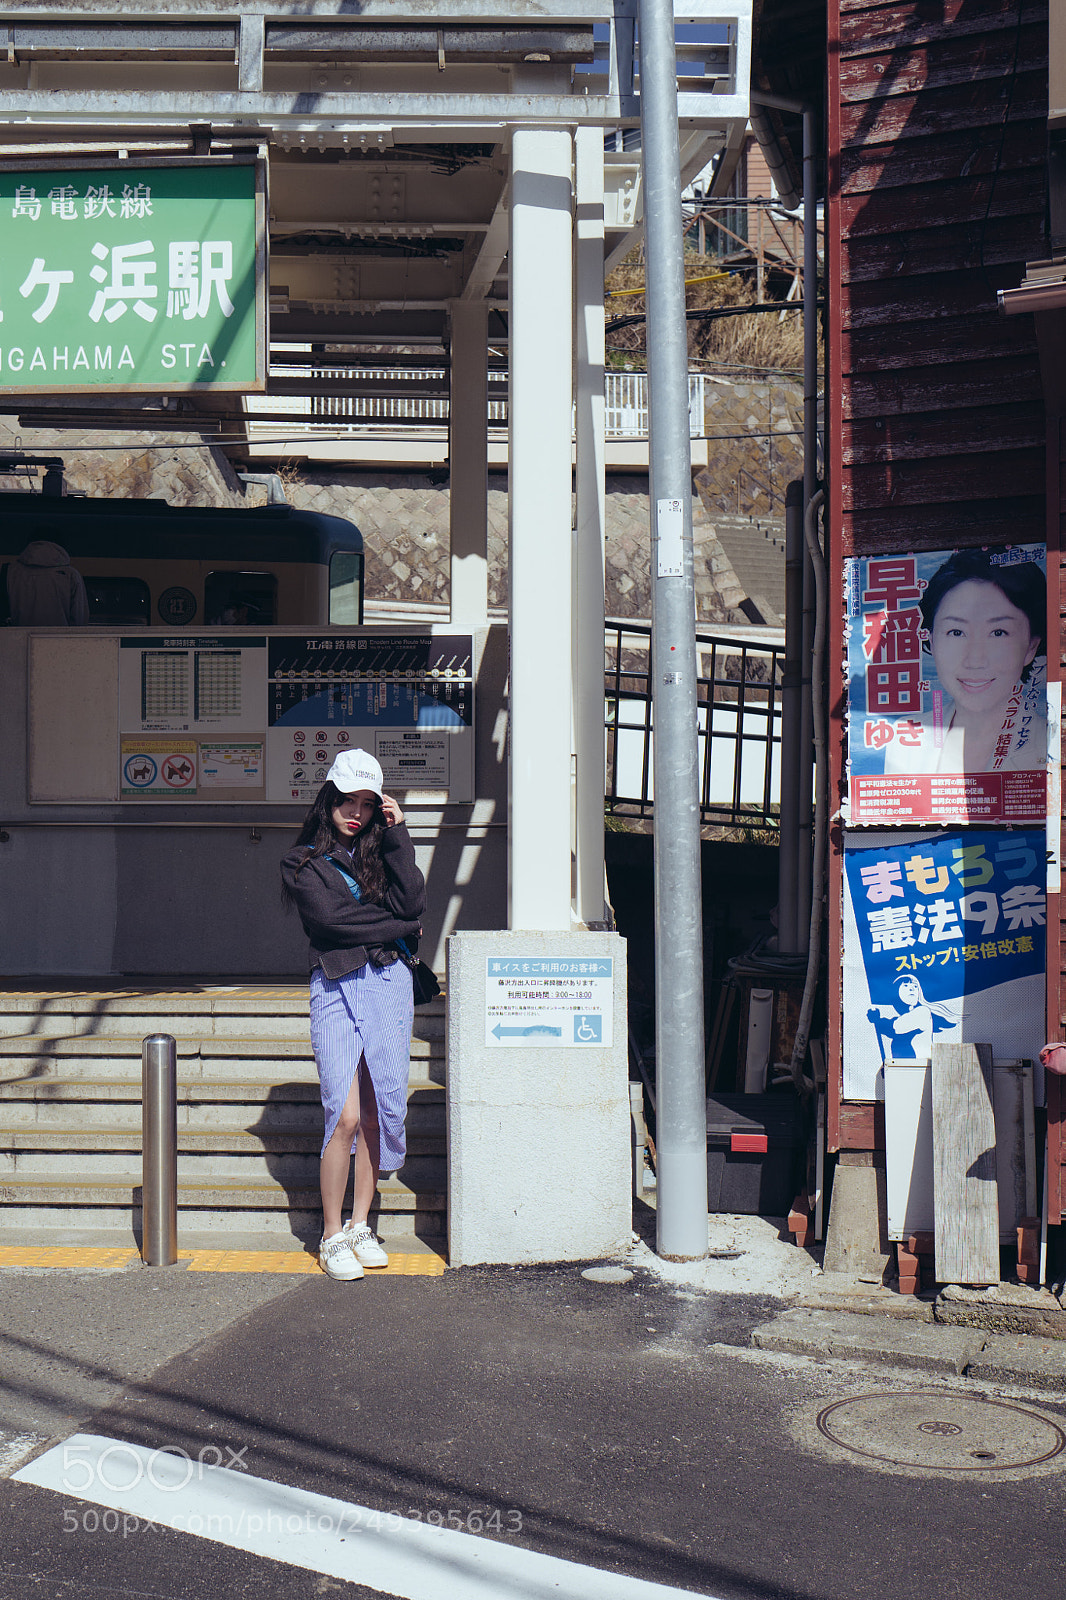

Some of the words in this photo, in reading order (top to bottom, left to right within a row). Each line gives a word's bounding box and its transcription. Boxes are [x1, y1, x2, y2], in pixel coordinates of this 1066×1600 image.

[160, 342, 227, 369] STA.
[990, 548, 1045, 565] 立憲民主党
[864, 558, 924, 715] 早稲田
[864, 720, 925, 750] ゆき
[860, 837, 1038, 903] まもろう
[866, 884, 1046, 953] 憲法9条
[491, 962, 608, 973] 車イスをご利用のお客様へ
